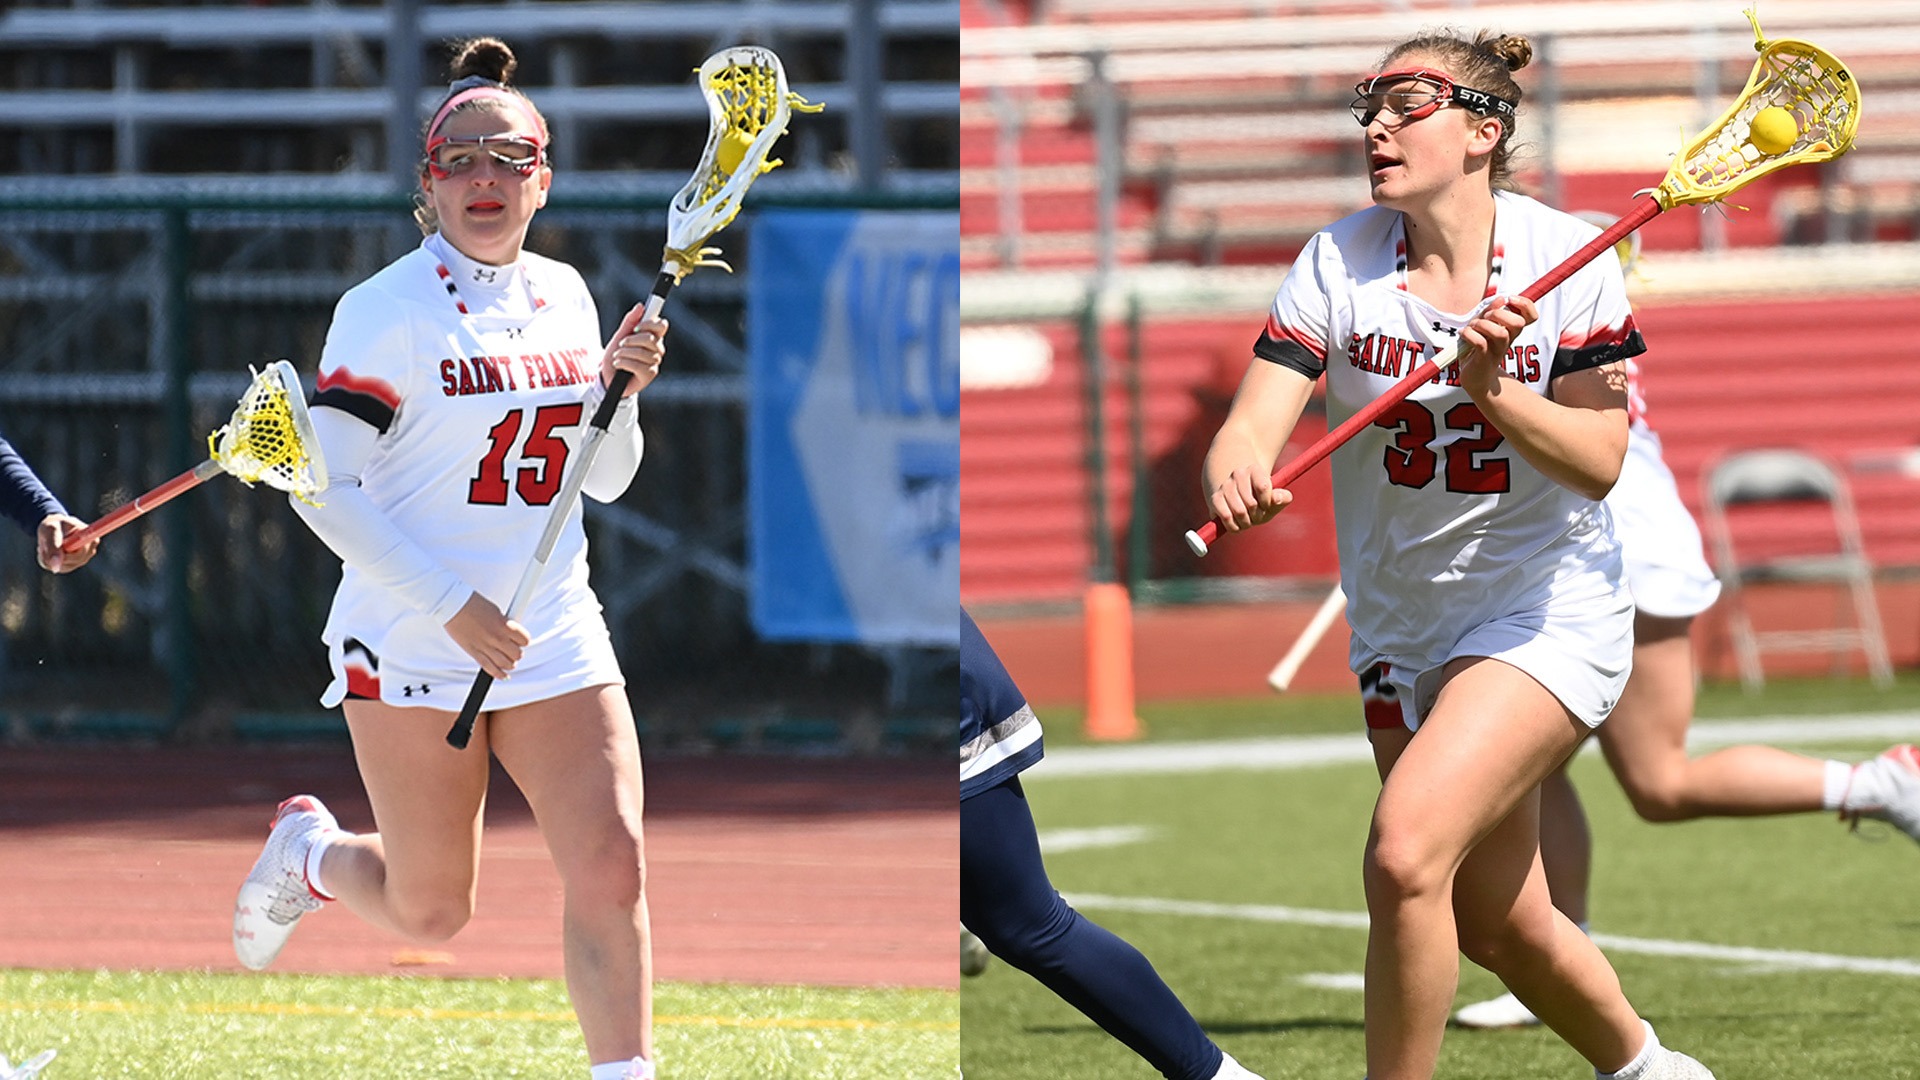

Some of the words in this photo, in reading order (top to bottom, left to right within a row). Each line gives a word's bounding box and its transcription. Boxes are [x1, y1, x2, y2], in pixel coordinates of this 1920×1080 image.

[1459, 88, 1490, 106] STX
[440, 355, 517, 396] SAINT
[520, 348, 597, 389] FRANC
[1348, 332, 1425, 378] SAINT
[467, 402, 583, 506] 15
[1374, 397, 1511, 493] 32
